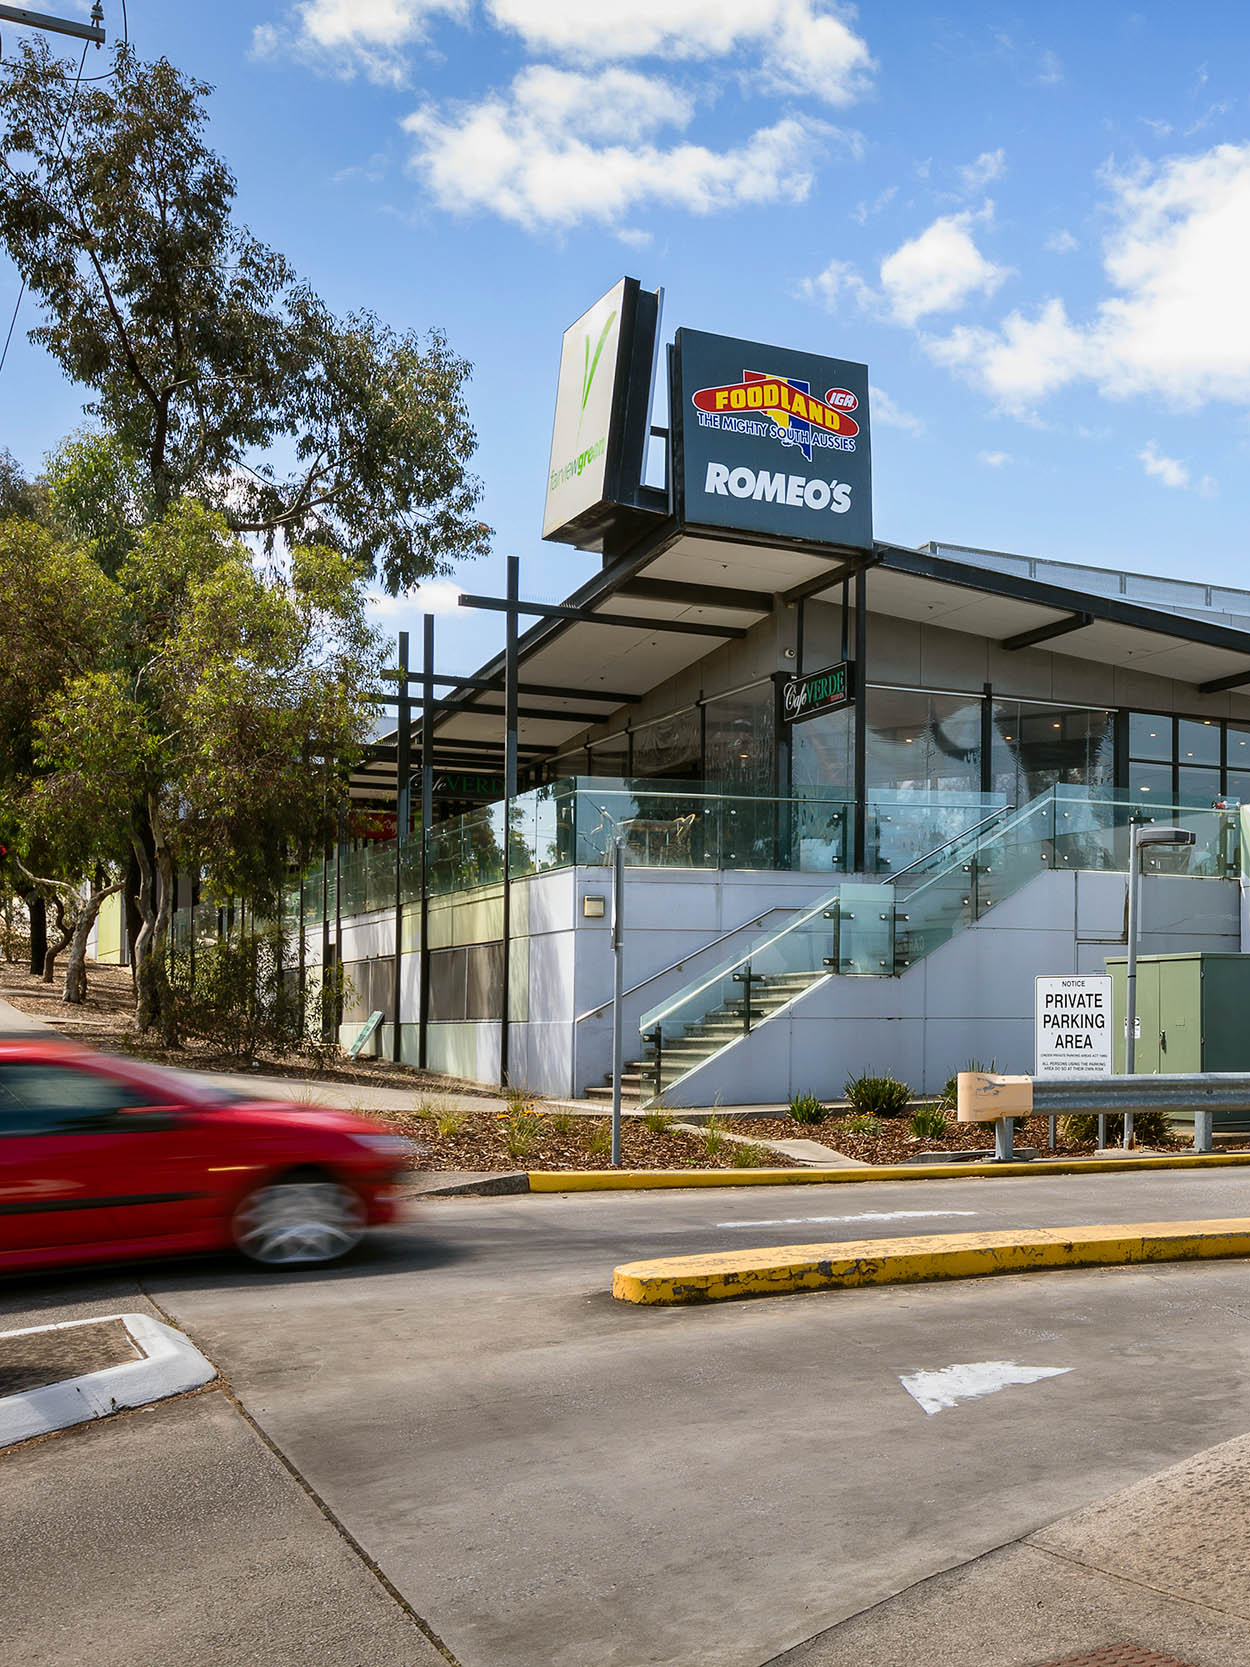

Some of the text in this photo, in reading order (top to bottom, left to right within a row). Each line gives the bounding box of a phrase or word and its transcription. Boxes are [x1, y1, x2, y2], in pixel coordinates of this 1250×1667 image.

[715, 384, 840, 430] FOODLAND
[829, 392, 855, 408] IGA
[697, 412, 857, 452] THE MIGHTY SOUTH AUSSIES
[704, 462, 852, 514] ROMEO'S
[806, 671, 845, 704] VERDE
[446, 775, 505, 793] VERD
[1061, 980, 1086, 988] NOTICE
[1045, 993, 1103, 1008] PRIVATE
[1043, 1014, 1105, 1029] PARKING
[1054, 1034, 1093, 1049] AREA
